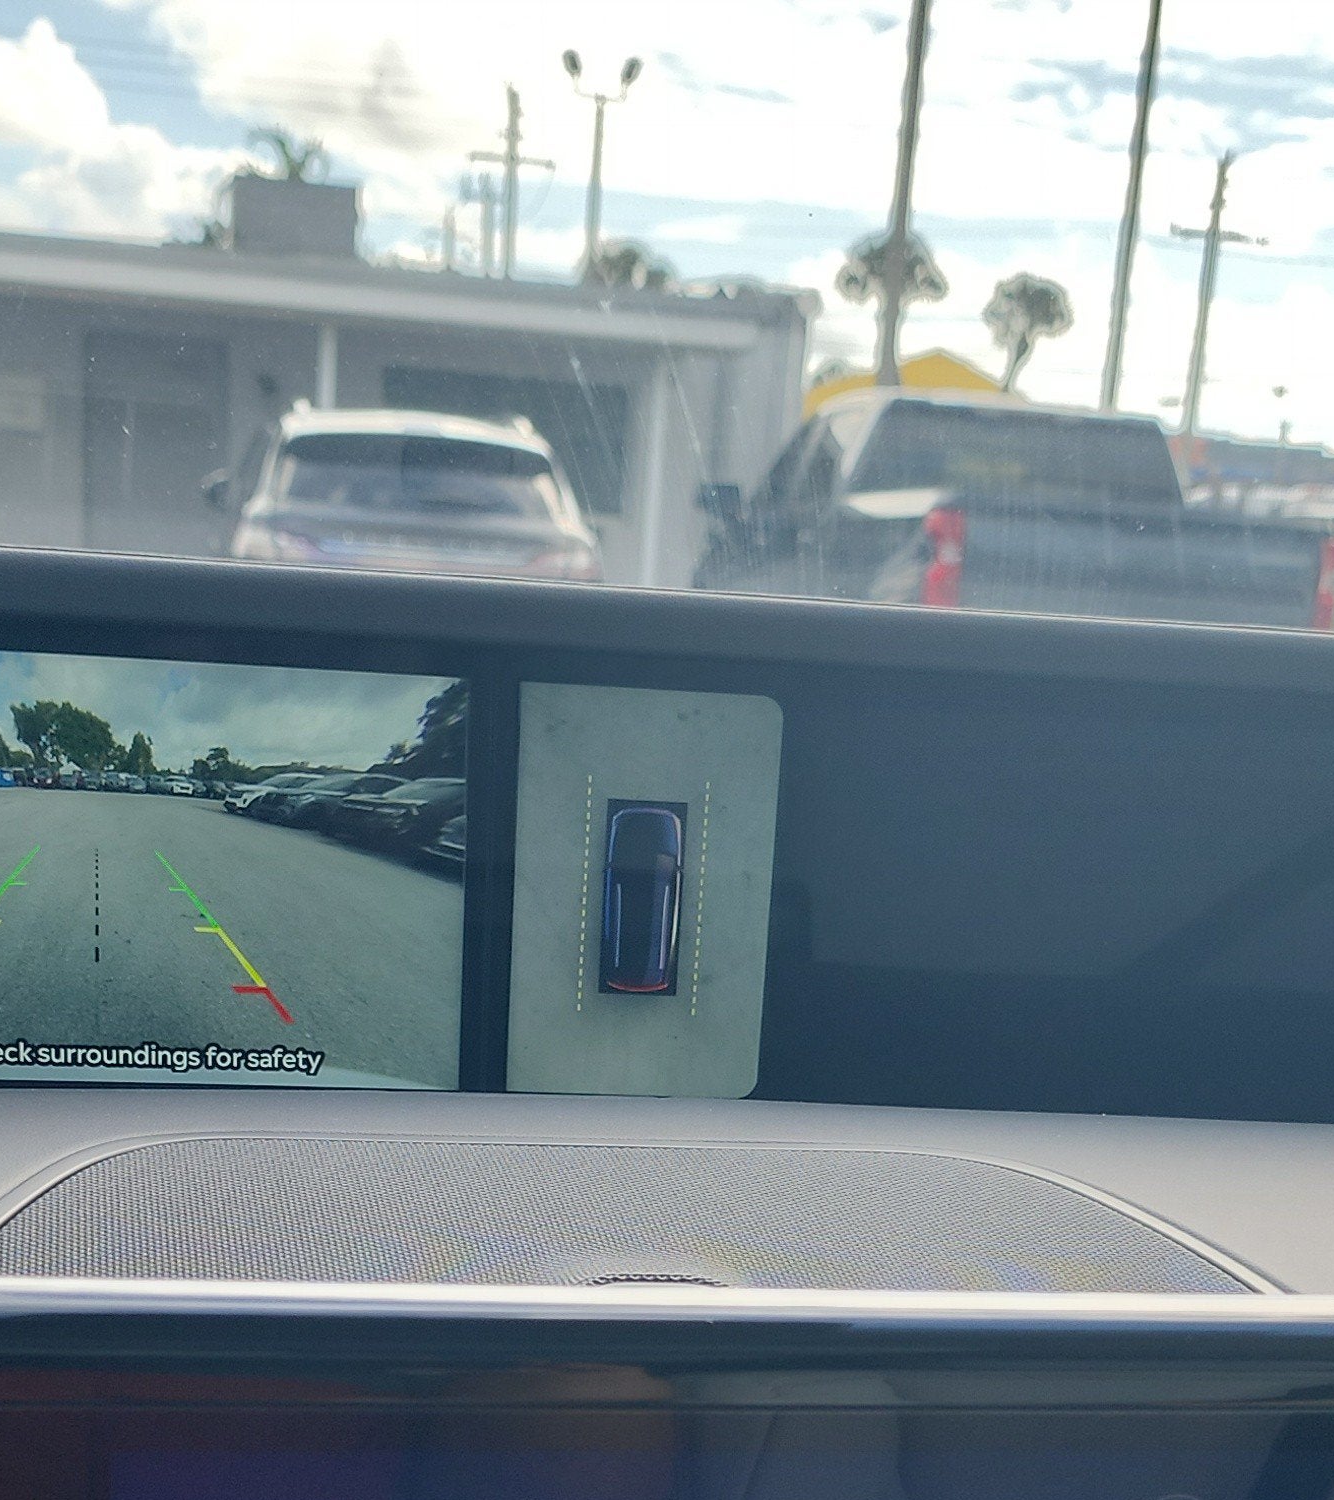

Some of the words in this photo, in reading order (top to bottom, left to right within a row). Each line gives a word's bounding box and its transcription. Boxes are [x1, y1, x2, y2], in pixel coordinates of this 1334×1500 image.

[37, 1044, 201, 1071] surroundings
[205, 1046, 244, 1068] for
[247, 1048, 322, 1074] safety
